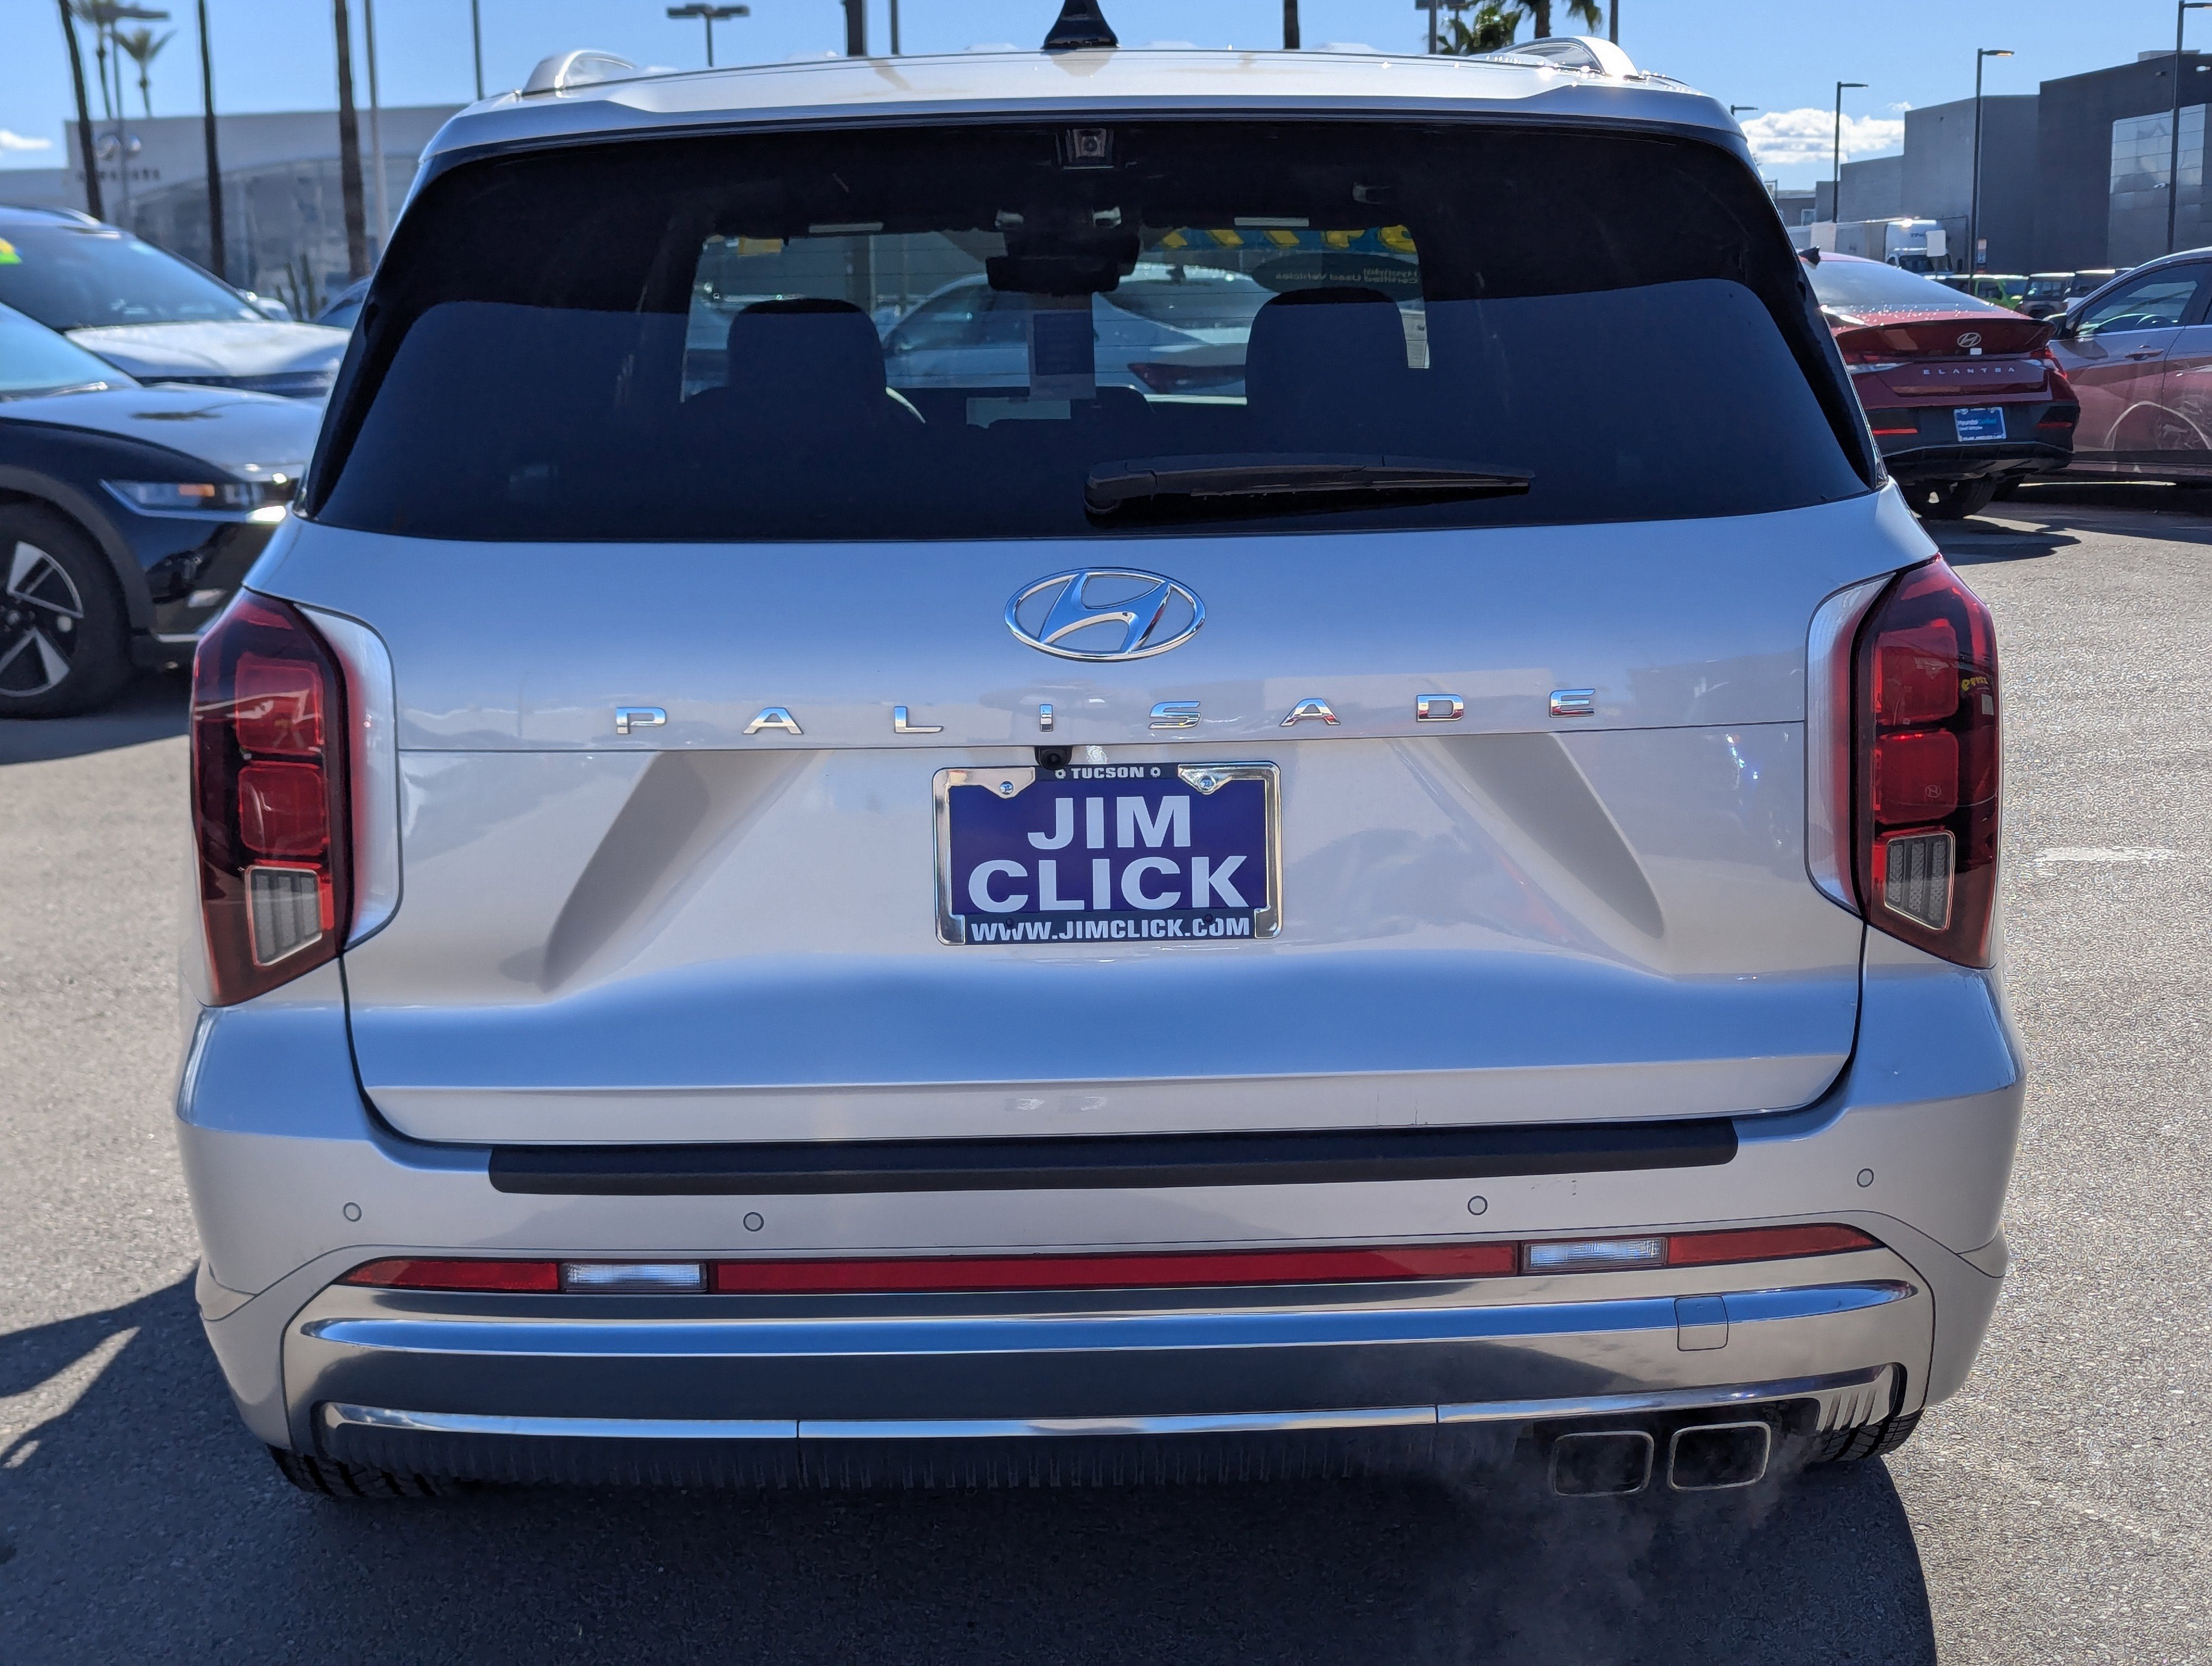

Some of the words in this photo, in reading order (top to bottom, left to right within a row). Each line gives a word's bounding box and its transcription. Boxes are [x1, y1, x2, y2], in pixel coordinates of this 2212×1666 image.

[614, 688, 1597, 736] PALISADE
[1071, 766, 1144, 779] TUCSON
[1027, 795, 1191, 850] JIM
[968, 855, 1250, 913] CLICK
[971, 917, 1250, 941] WWW.JIMCLICK.COM
